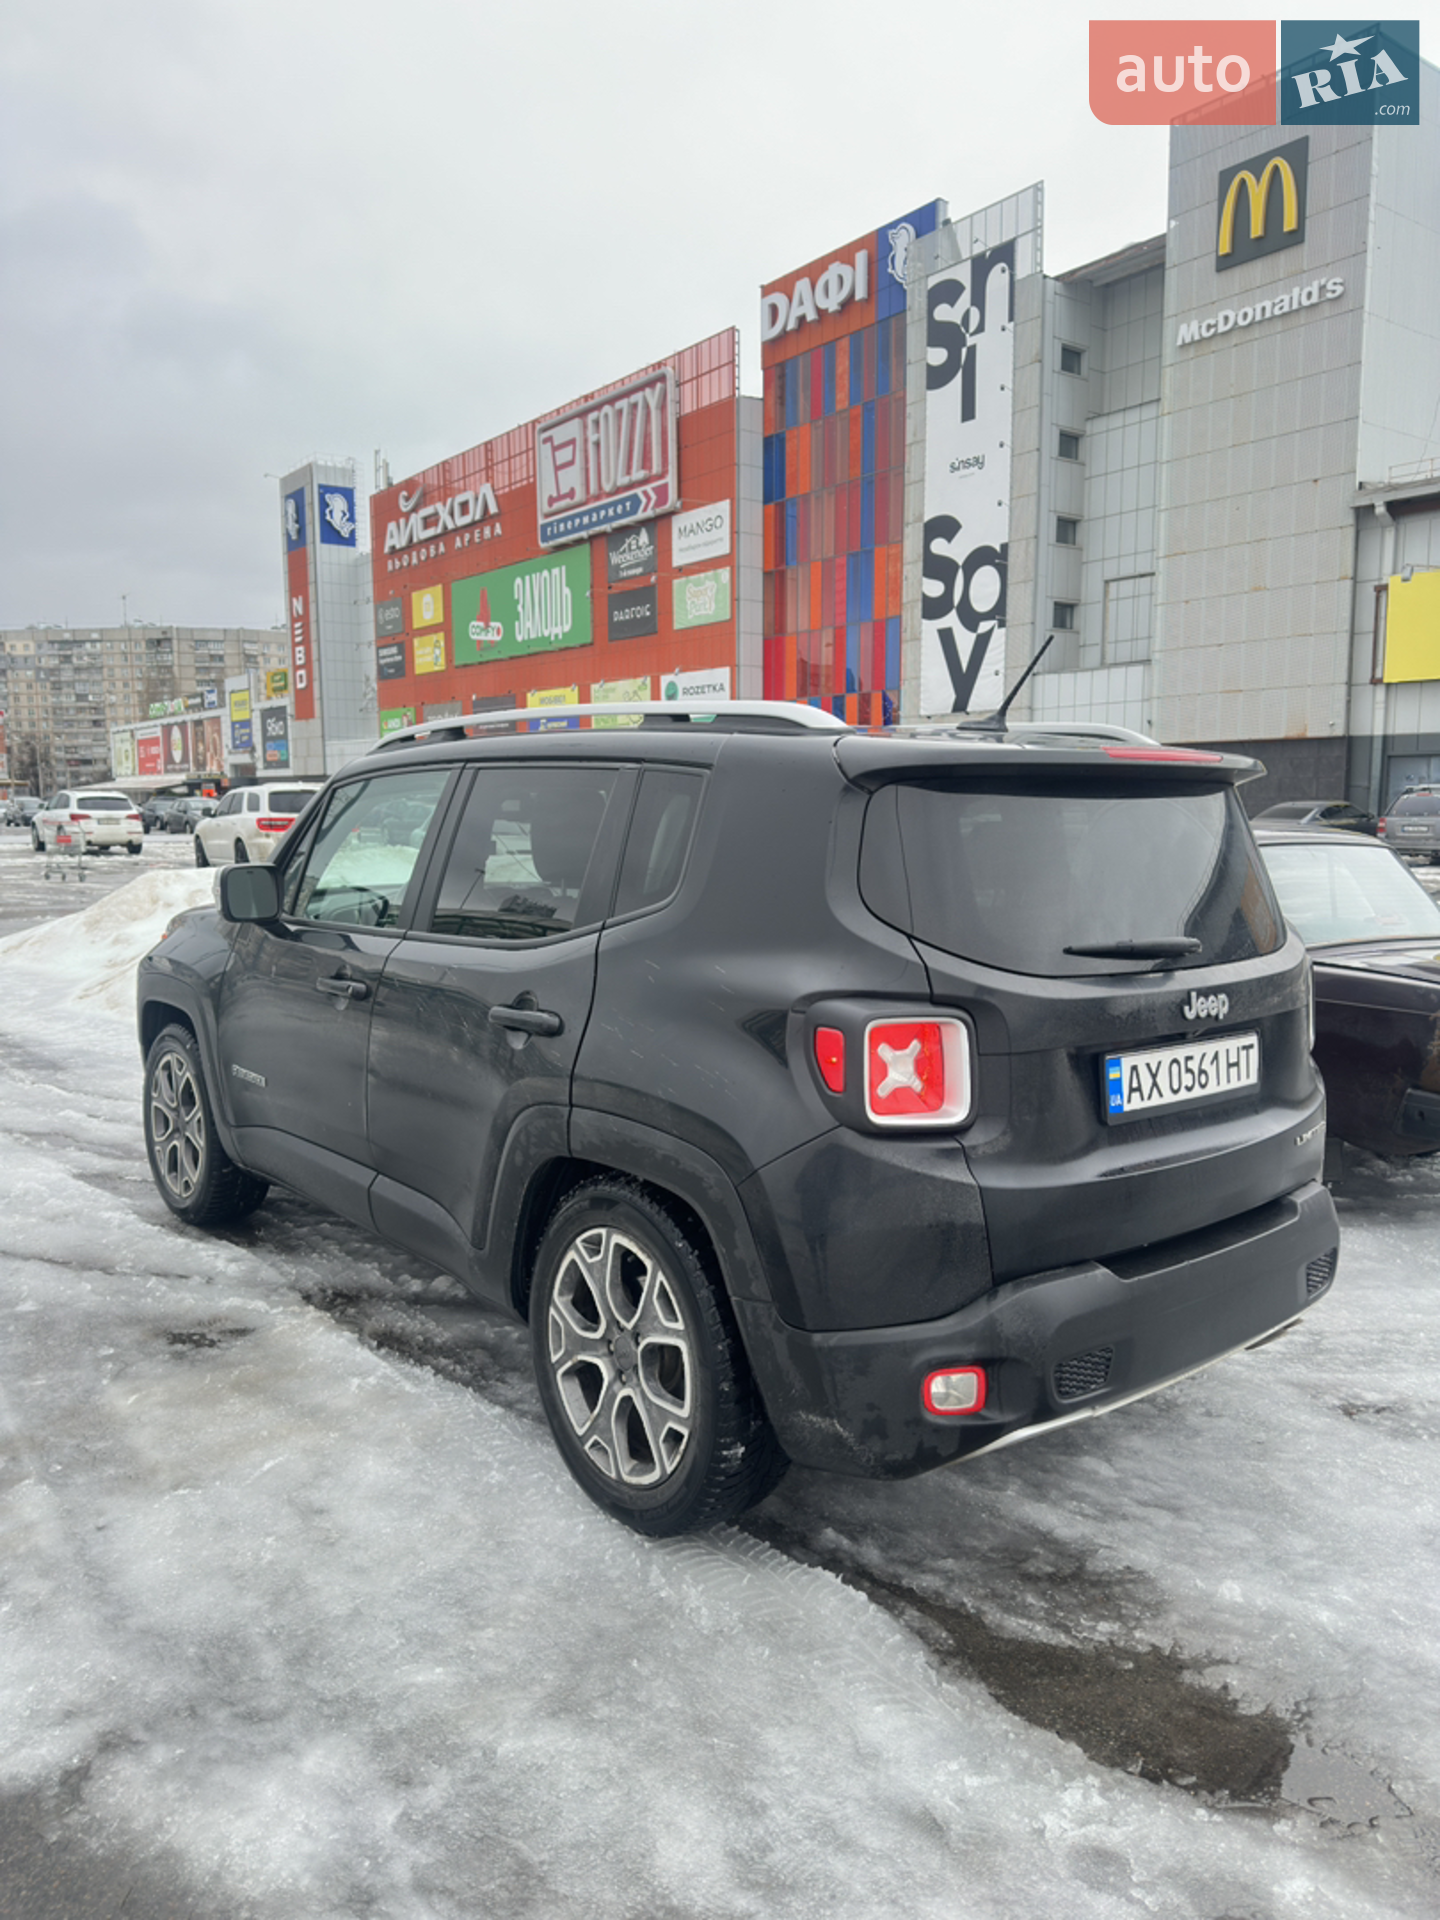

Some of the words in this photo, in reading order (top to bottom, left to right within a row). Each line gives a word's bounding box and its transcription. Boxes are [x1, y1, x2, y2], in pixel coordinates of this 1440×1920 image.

[1176, 276, 1346, 347] McDonald's
[587, 382, 666, 498] FOZZY
[949, 453, 985, 474] sinsay
[546, 500, 633, 536] гіпермаркет
[678, 514, 725, 541] MANGO
[454, 522, 503, 551] АРЕНА
[514, 565, 573, 643] ЗАХОДЬ
[682, 682, 726, 697] ROZETKA
[1183, 990, 1229, 1020] Jeep
